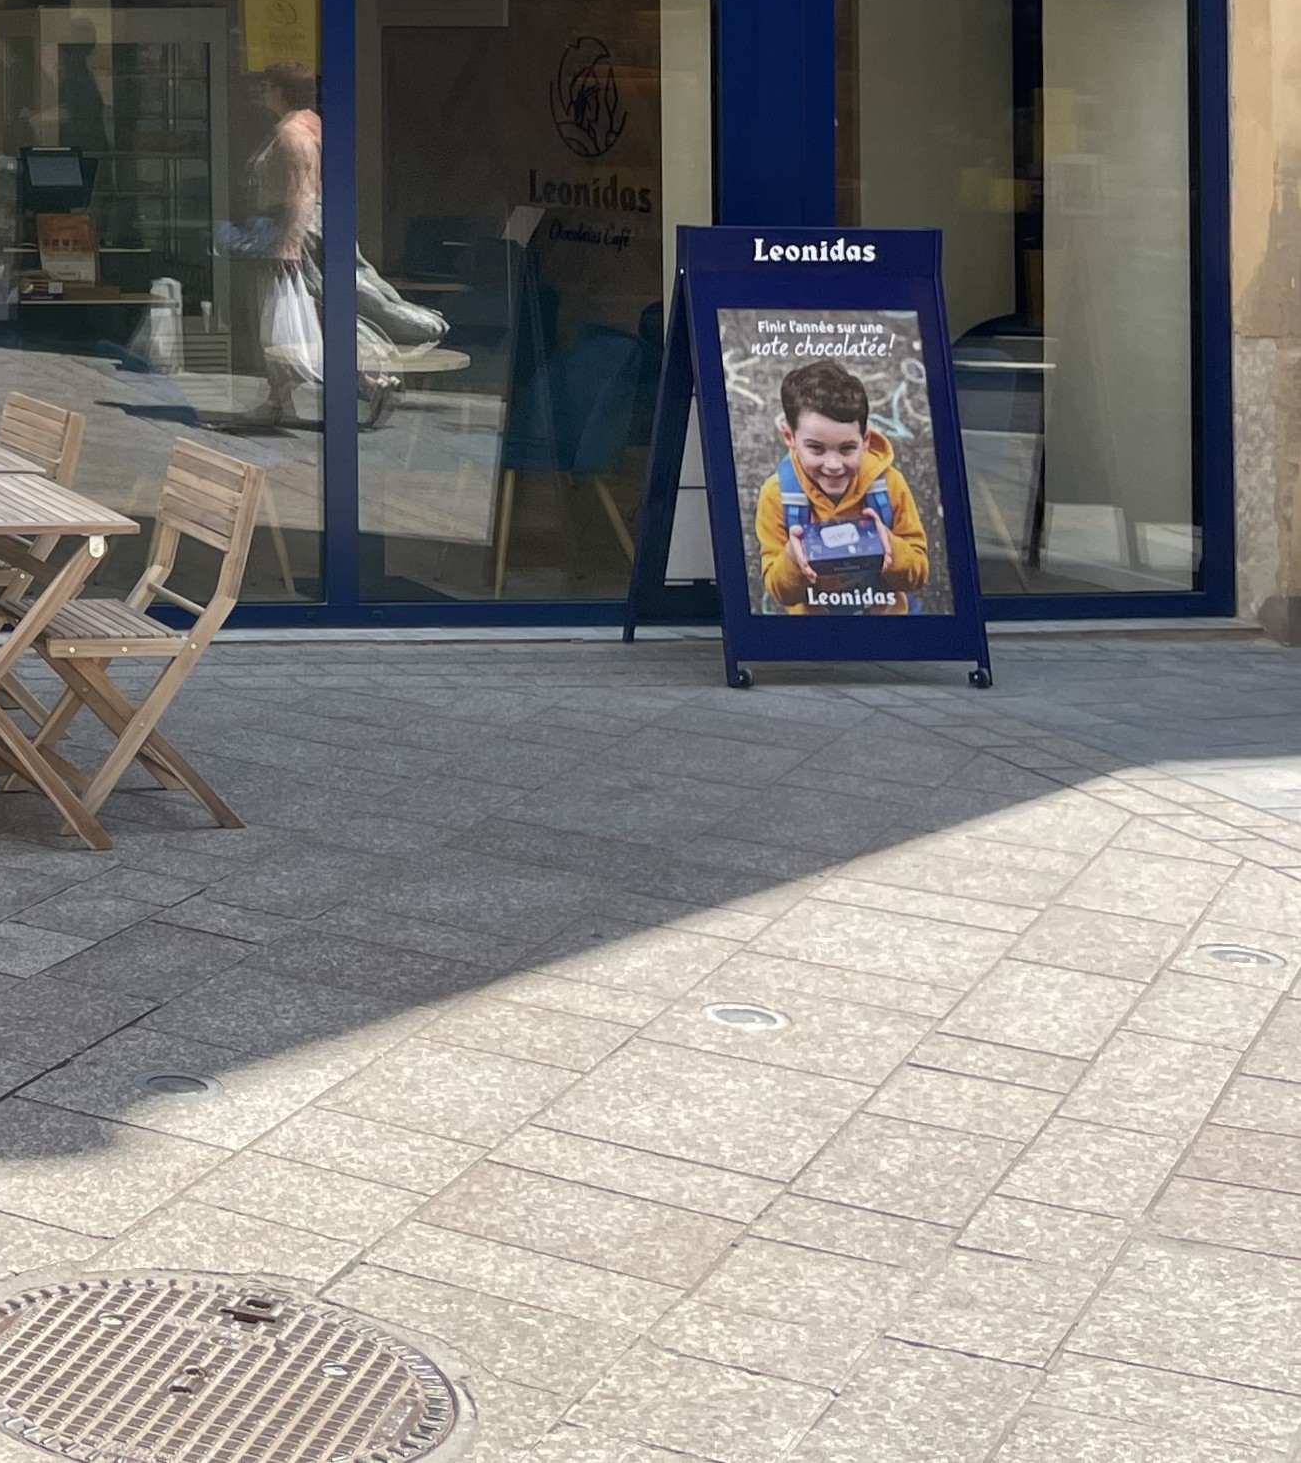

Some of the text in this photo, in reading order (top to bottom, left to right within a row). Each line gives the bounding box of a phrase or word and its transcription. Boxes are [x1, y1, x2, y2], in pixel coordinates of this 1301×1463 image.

[529, 168, 652, 213] Leonidas
[753, 237, 876, 262] Leonidas
[757, 320, 884, 334] Finir l'année sur une
[751, 333, 896, 357] note chocolatée!
[807, 587, 897, 606] Leonidas
